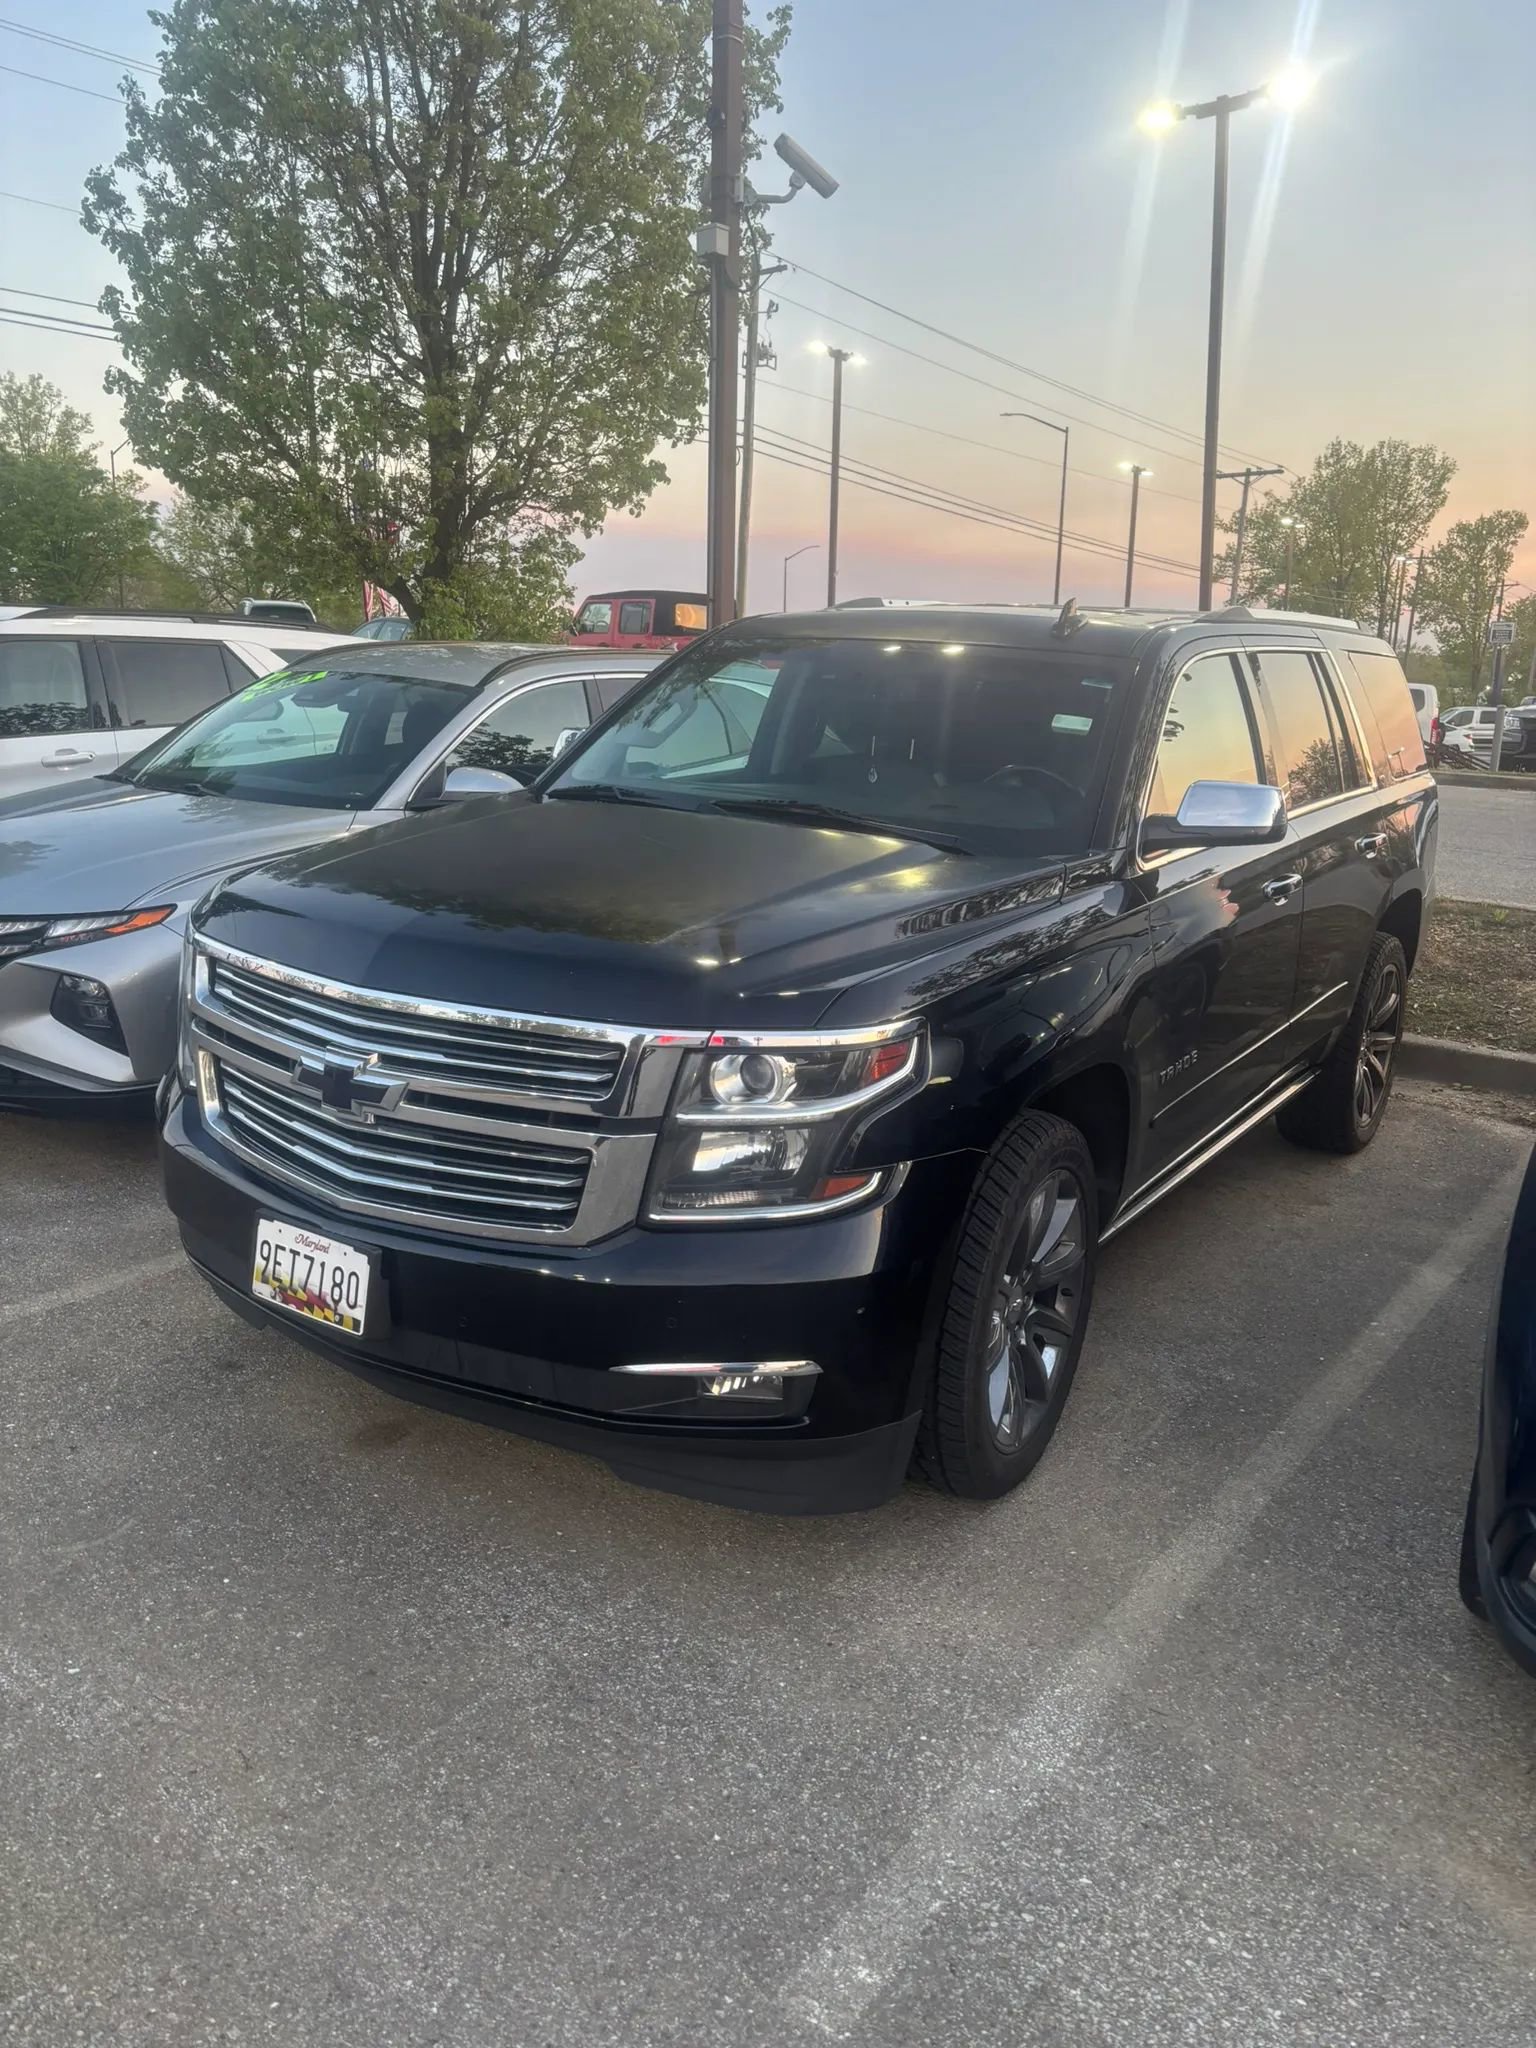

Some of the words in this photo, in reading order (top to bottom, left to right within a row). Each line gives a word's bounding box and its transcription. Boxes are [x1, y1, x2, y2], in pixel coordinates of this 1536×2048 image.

[1160, 1050, 1198, 1085] TAHOE
[294, 1233, 331, 1255] Maryland
[260, 1240, 360, 1309] 9ET7180
